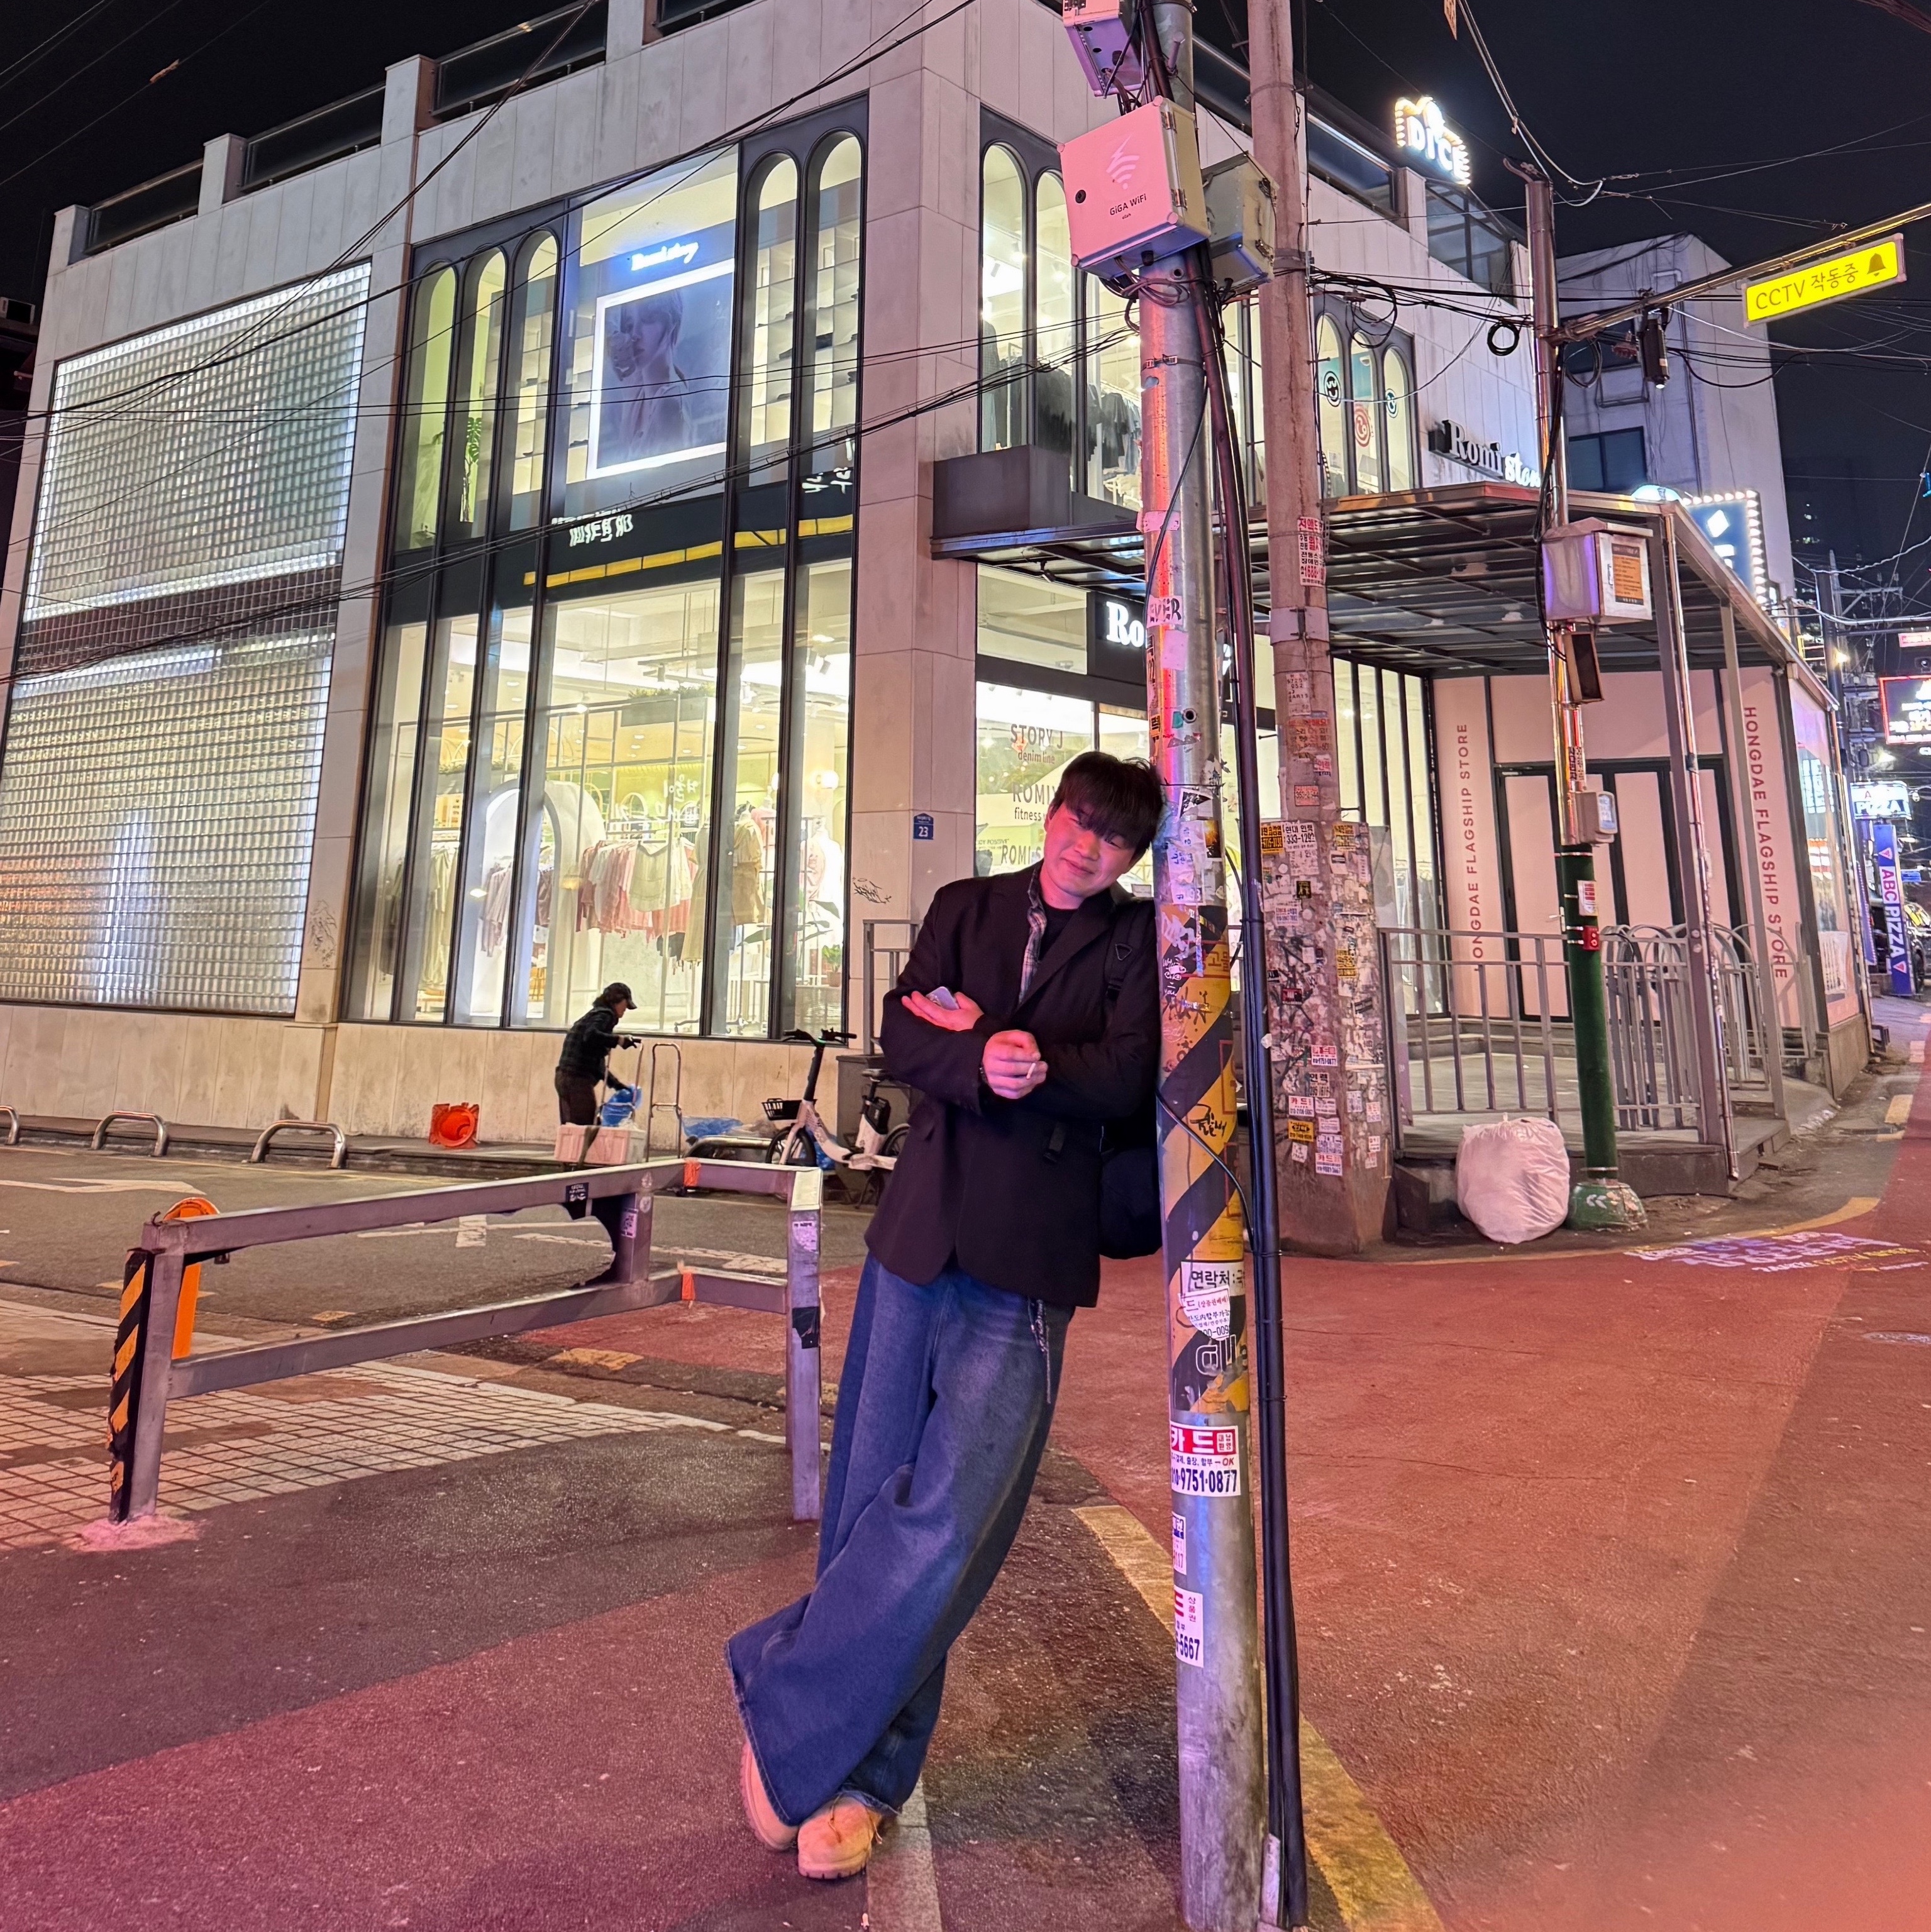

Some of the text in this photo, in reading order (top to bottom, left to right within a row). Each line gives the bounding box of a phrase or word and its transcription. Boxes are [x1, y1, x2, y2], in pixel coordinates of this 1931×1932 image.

[1110, 193, 1147, 216] GiGA WiFi
[1756, 263, 1859, 310] CCTV 작동중
[1447, 419, 1503, 477] Romi
[1106, 601, 1145, 648] Ro
[1010, 724, 1063, 749] STORY J
[1018, 749, 1055, 765] denim line
[1012, 782, 1056, 805] ROMI
[1014, 807, 1042, 822] fitness
[919, 826, 928, 837] 23
[1744, 707, 1788, 978] HONGDAE FLAGSHIP STORE
[1001, 844, 1031, 865] ROMI
[1457, 724, 1483, 972] ONGDAE FLAGSHIP STORE
[1881, 868, 1906, 959] ABC PIZZA
[1171, 1427, 1214, 1454] 카드
[1222, 1457, 1234, 1466] OK
